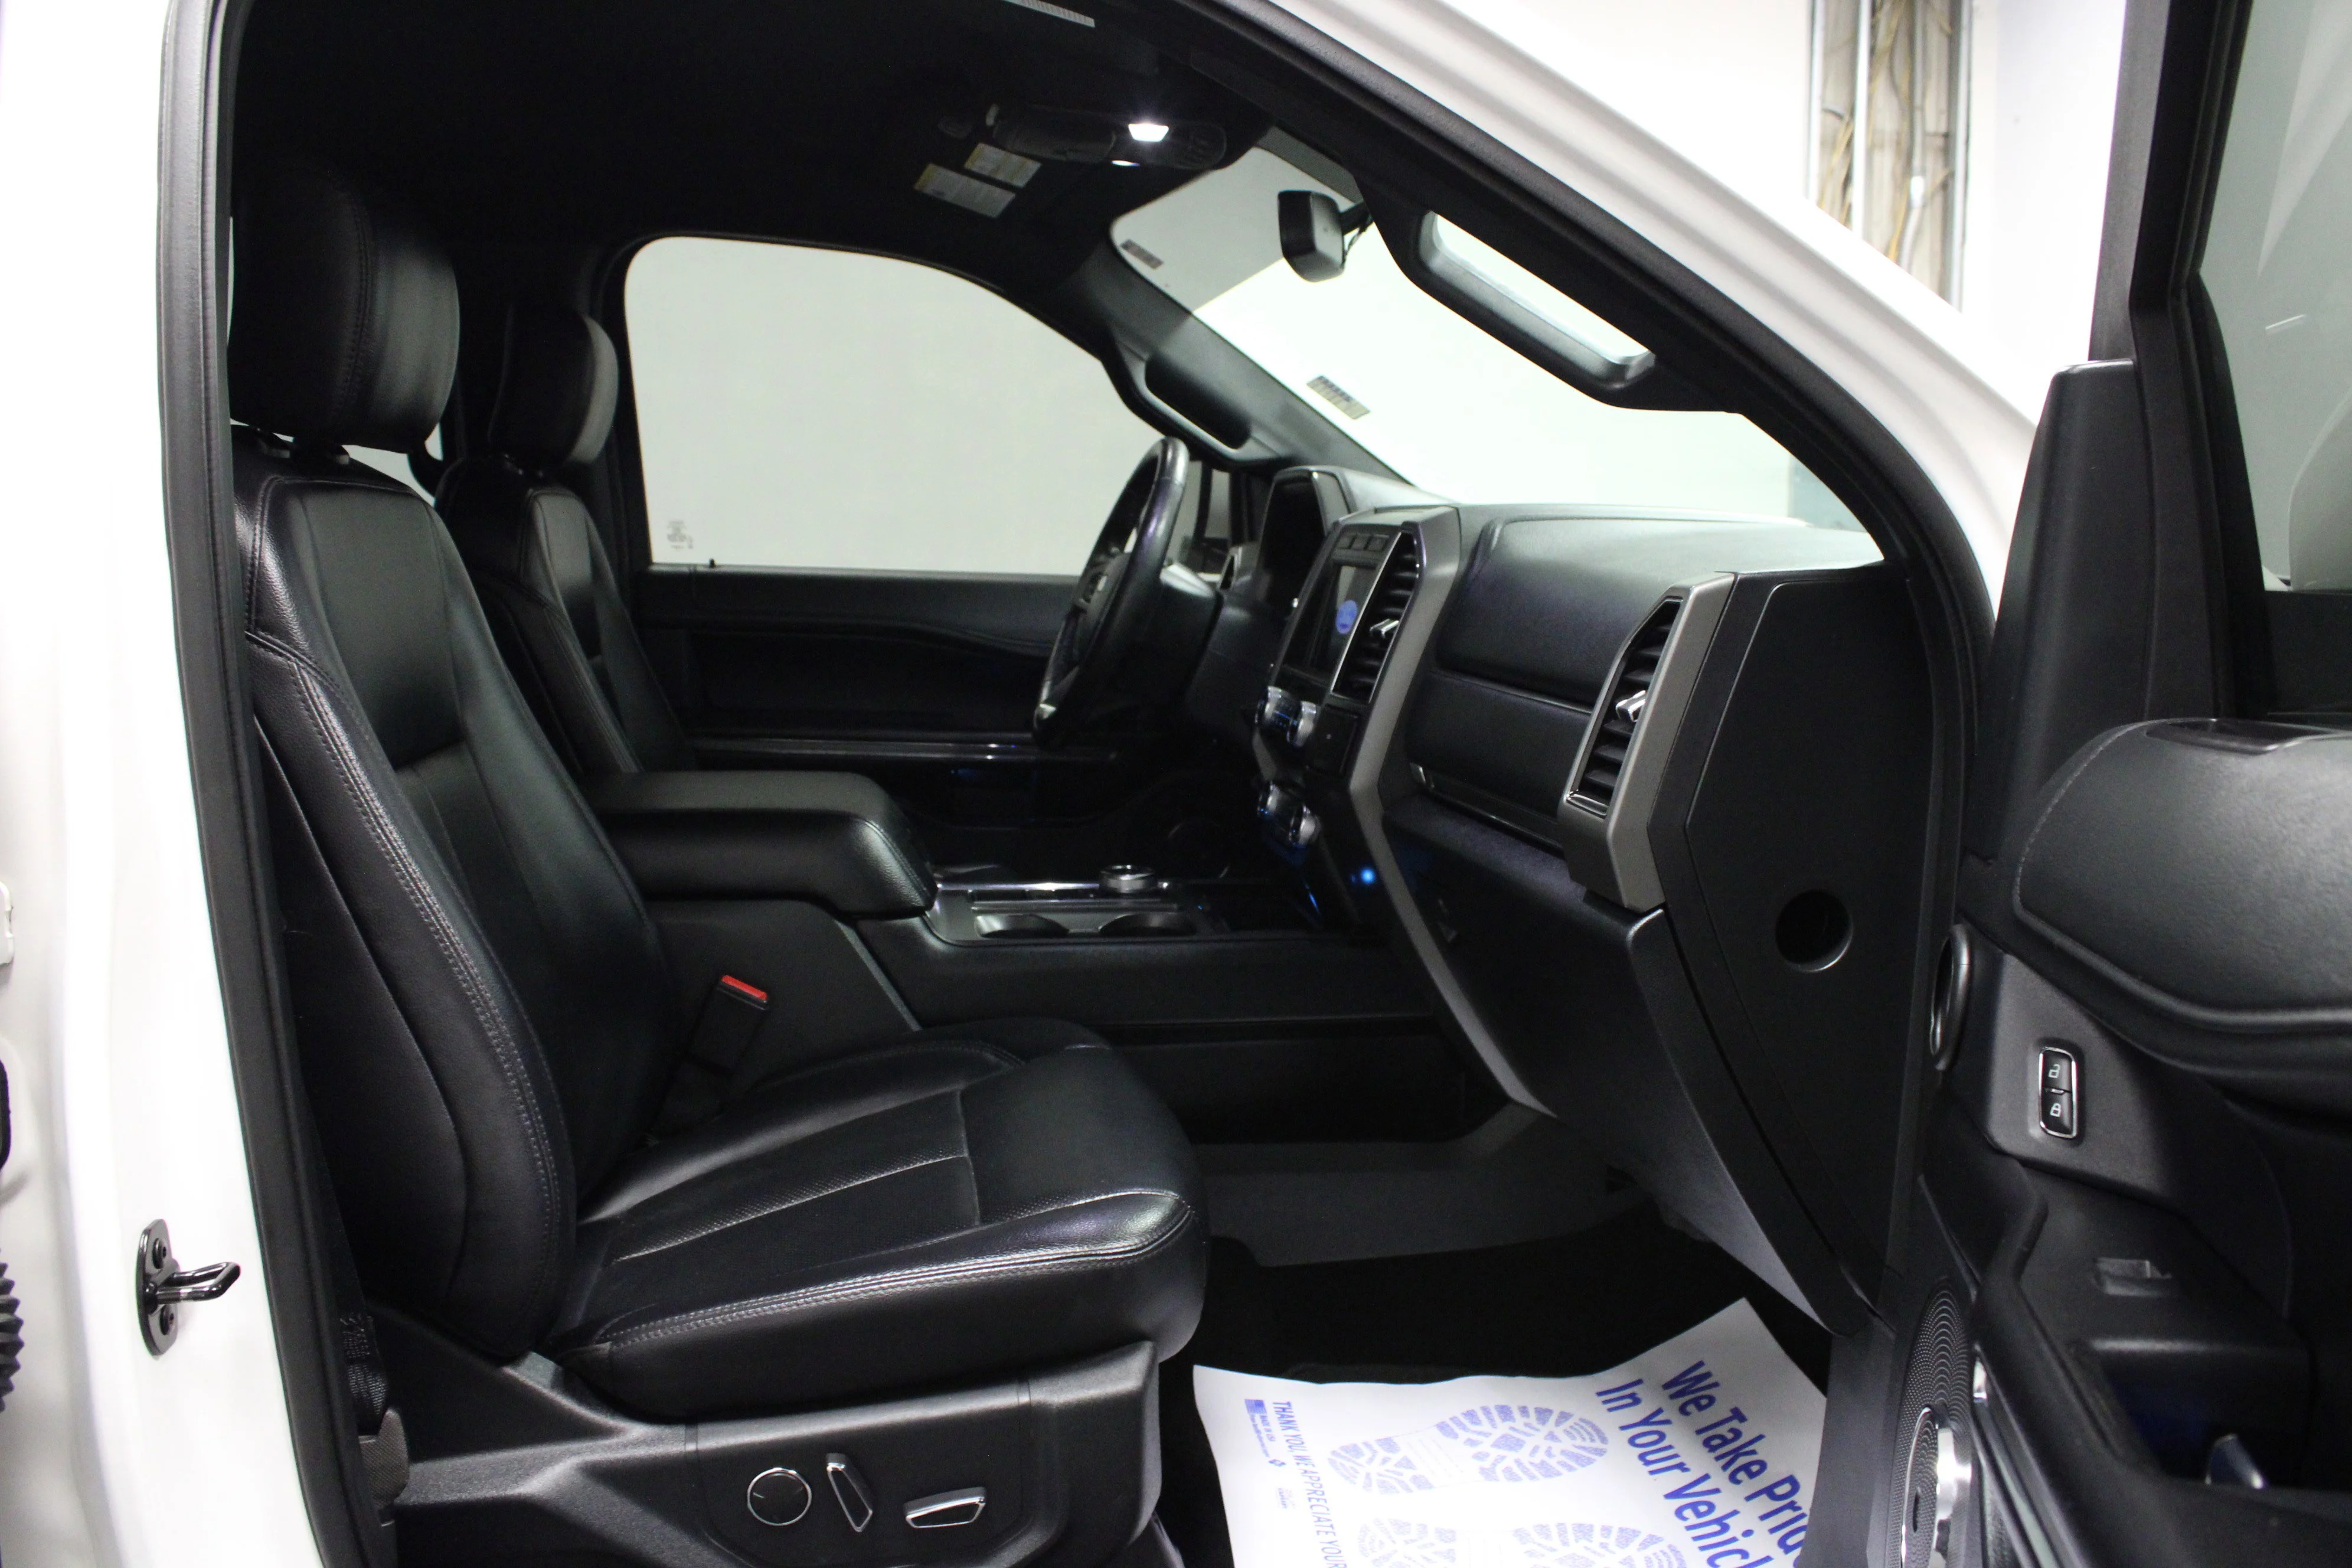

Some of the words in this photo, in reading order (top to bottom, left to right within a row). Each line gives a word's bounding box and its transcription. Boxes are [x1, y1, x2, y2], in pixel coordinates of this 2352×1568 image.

[1595, 1378, 1644, 1412] In
[1272, 1401, 1301, 1432] THANK
[1661, 1360, 1720, 1416] We
[1694, 1406, 1768, 1485] Take
[1283, 1434, 1308, 1452] YOU,
[1618, 1407, 1691, 1475] Your
[1292, 1455, 1315, 1468] WE
[1298, 1468, 1337, 1536] APPRECIATE
